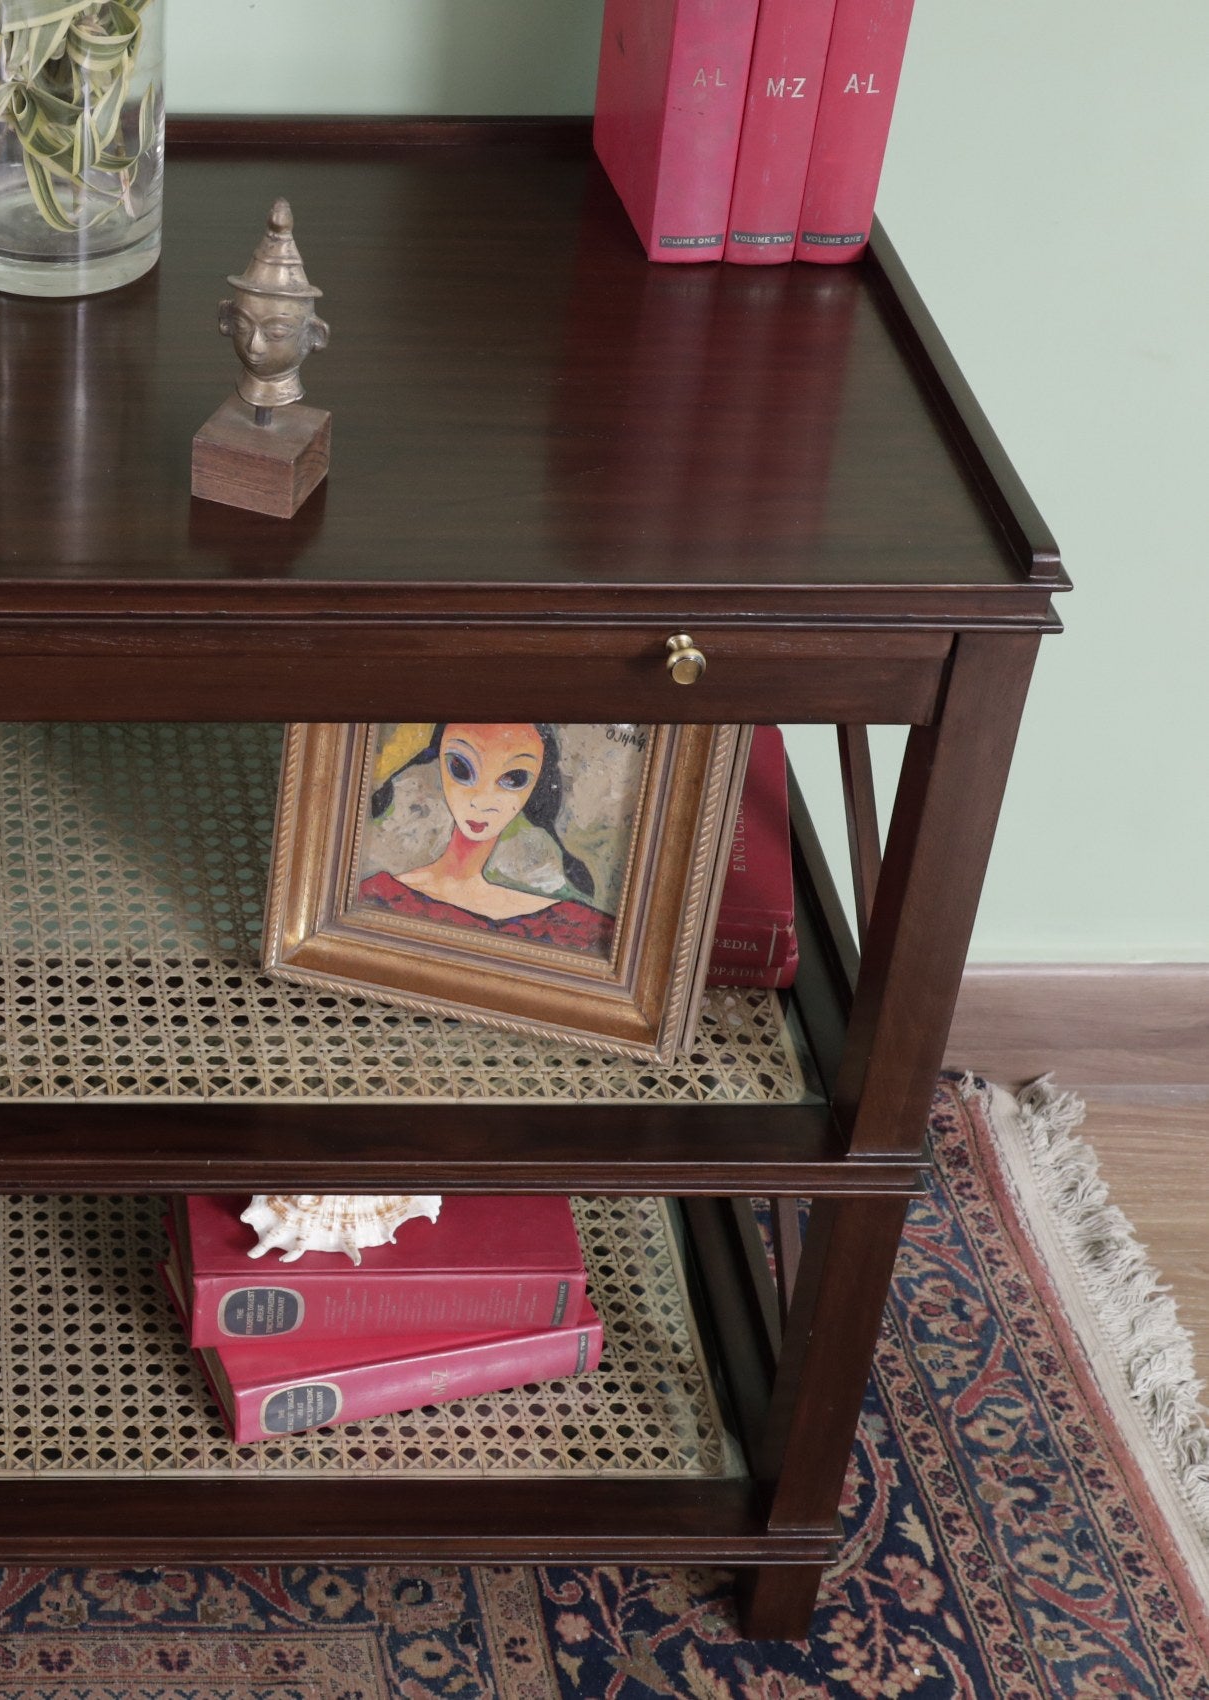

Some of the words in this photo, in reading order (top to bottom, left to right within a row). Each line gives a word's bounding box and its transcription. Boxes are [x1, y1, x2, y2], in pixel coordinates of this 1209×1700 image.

[693, 68, 727, 88] A-L
[766, 77, 807, 98] M-Z
[843, 73, 881, 94] A-L
[660, 237, 696, 246] VOLUME
[697, 236, 717, 245] ONE
[734, 234, 771, 244] VOLUME
[773, 234, 793, 244] TWO
[805, 234, 842, 244] VOLUME
[843, 235, 863, 244] ONE
[431, 1368, 448, 1397] M-Z
